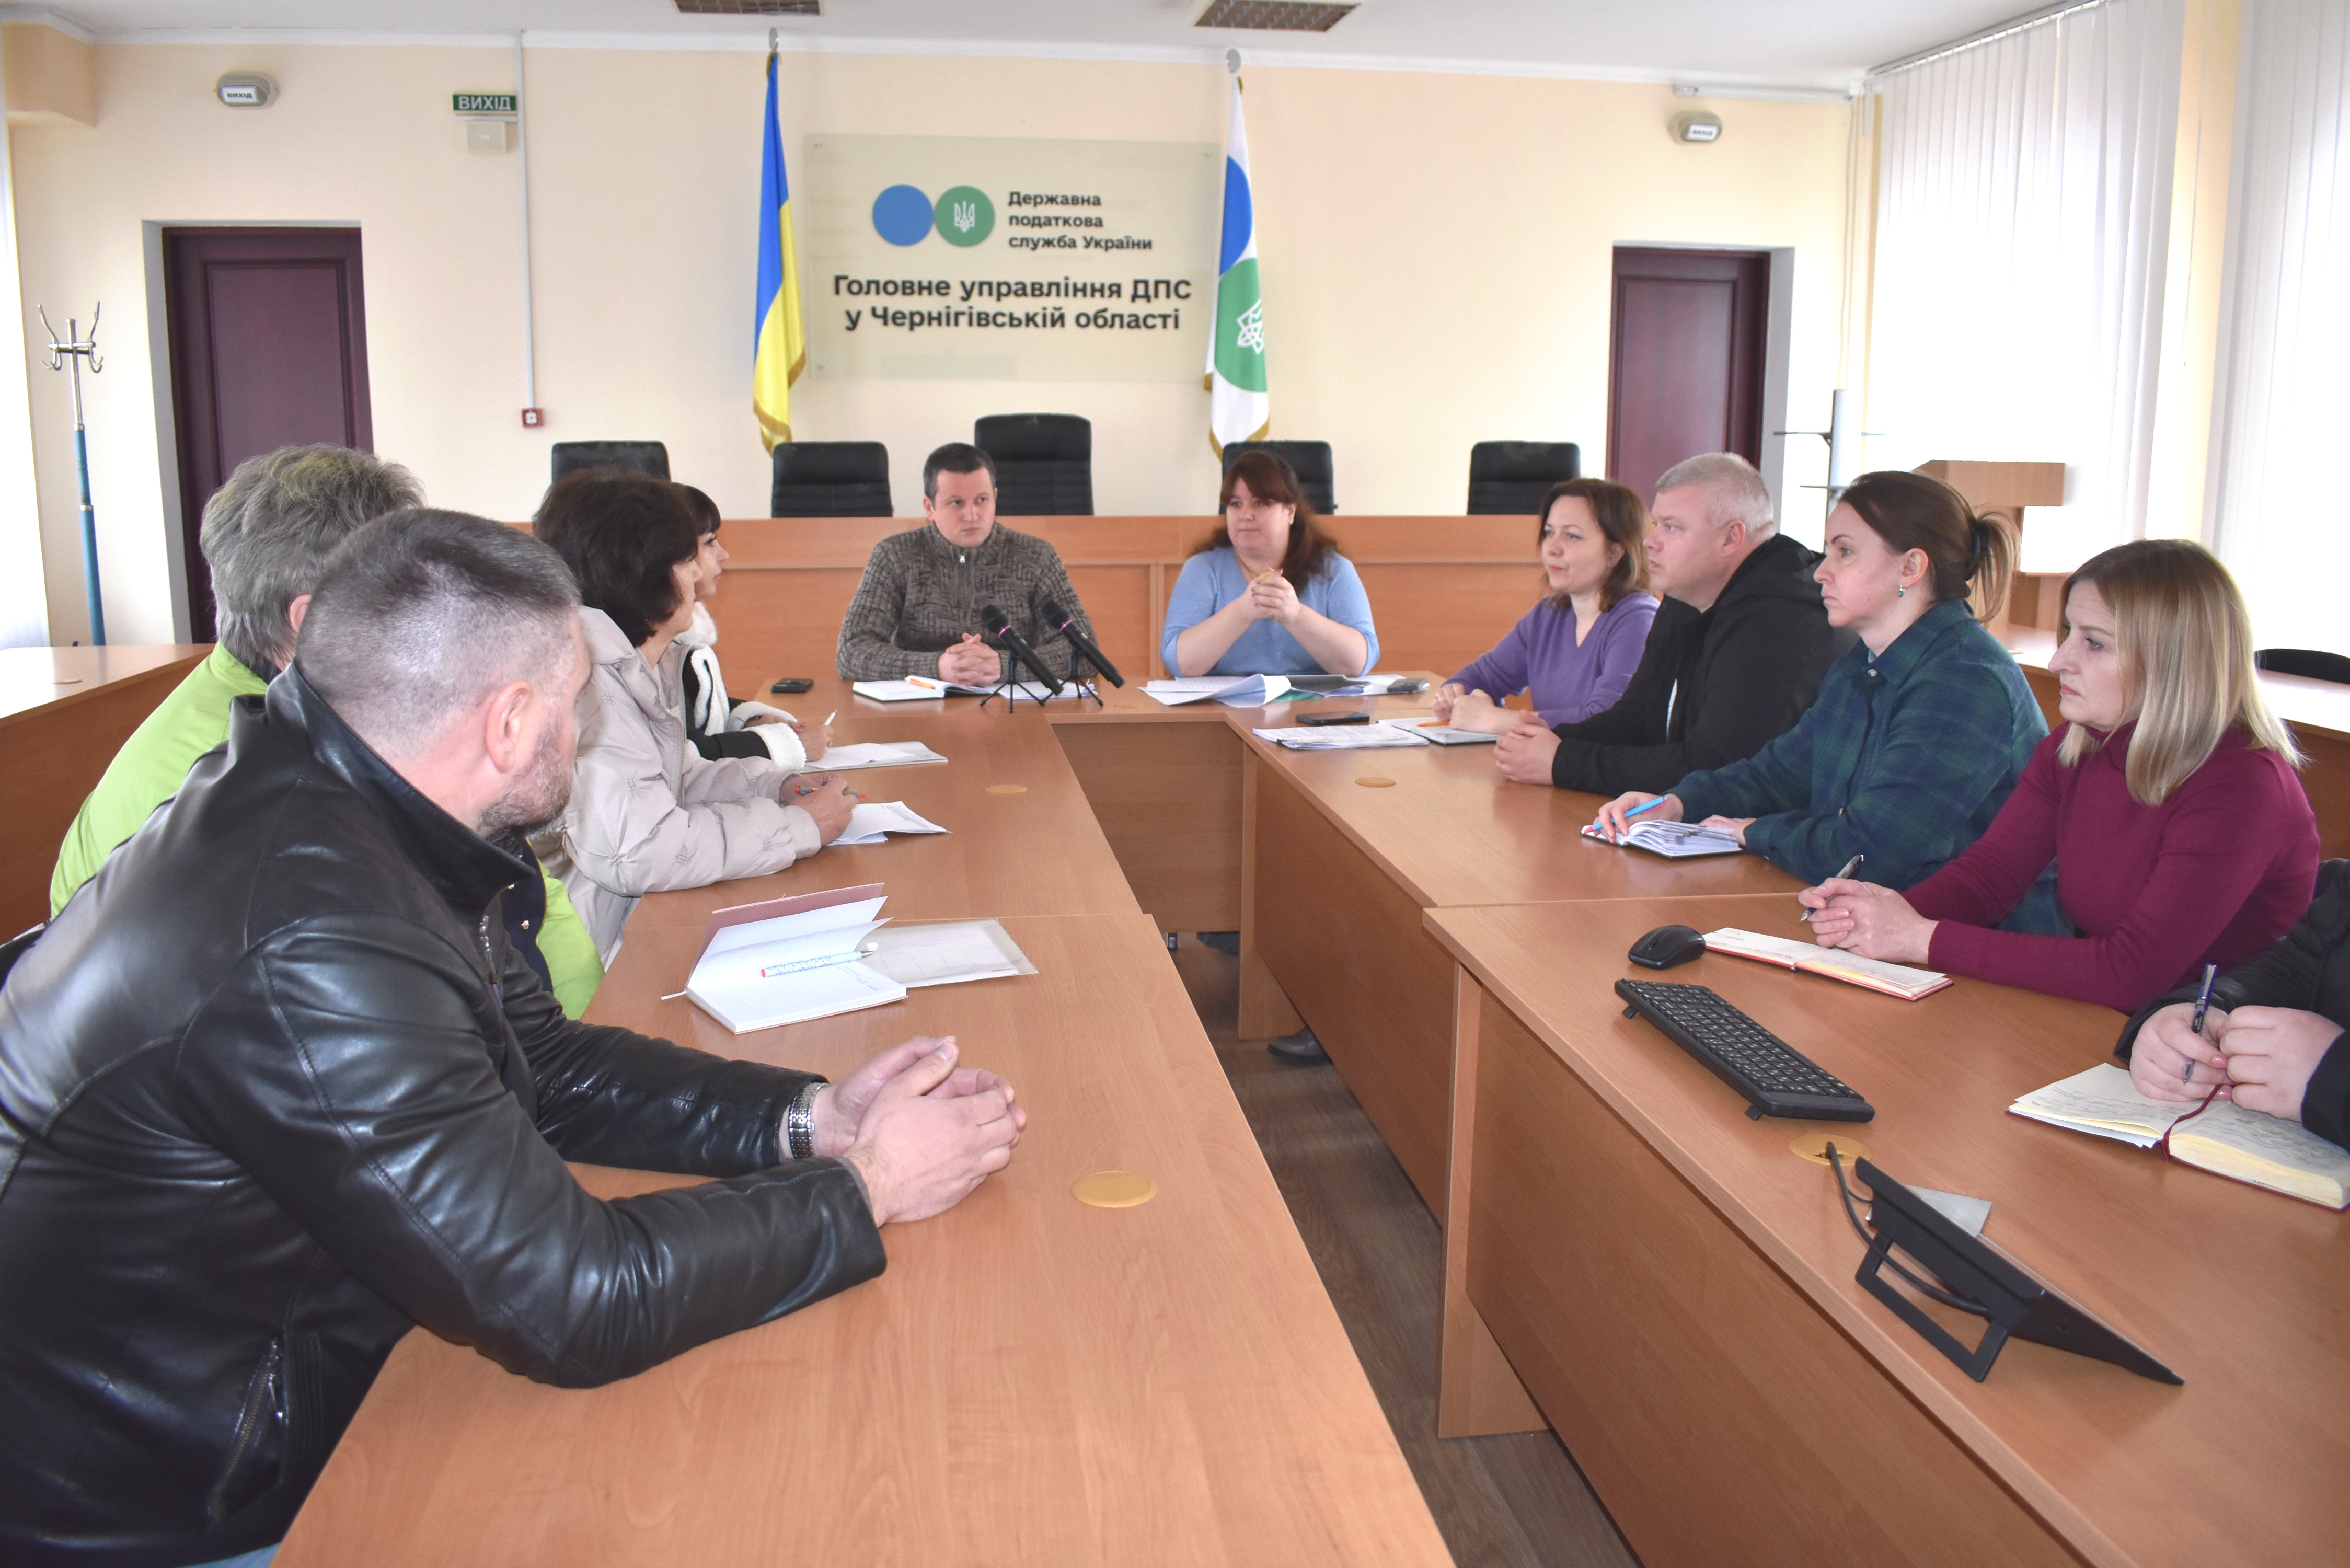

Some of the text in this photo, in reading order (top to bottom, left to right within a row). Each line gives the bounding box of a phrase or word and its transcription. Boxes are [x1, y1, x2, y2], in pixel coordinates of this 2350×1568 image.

[458, 95, 512, 110] ВИХІД
[1008, 191, 1102, 207] Державна
[1008, 215, 1104, 229] податкова
[1008, 234, 1153, 252] служба України
[833, 274, 1192, 304] Головне управління ДПС
[844, 305, 1180, 332] у Чернігівській області
